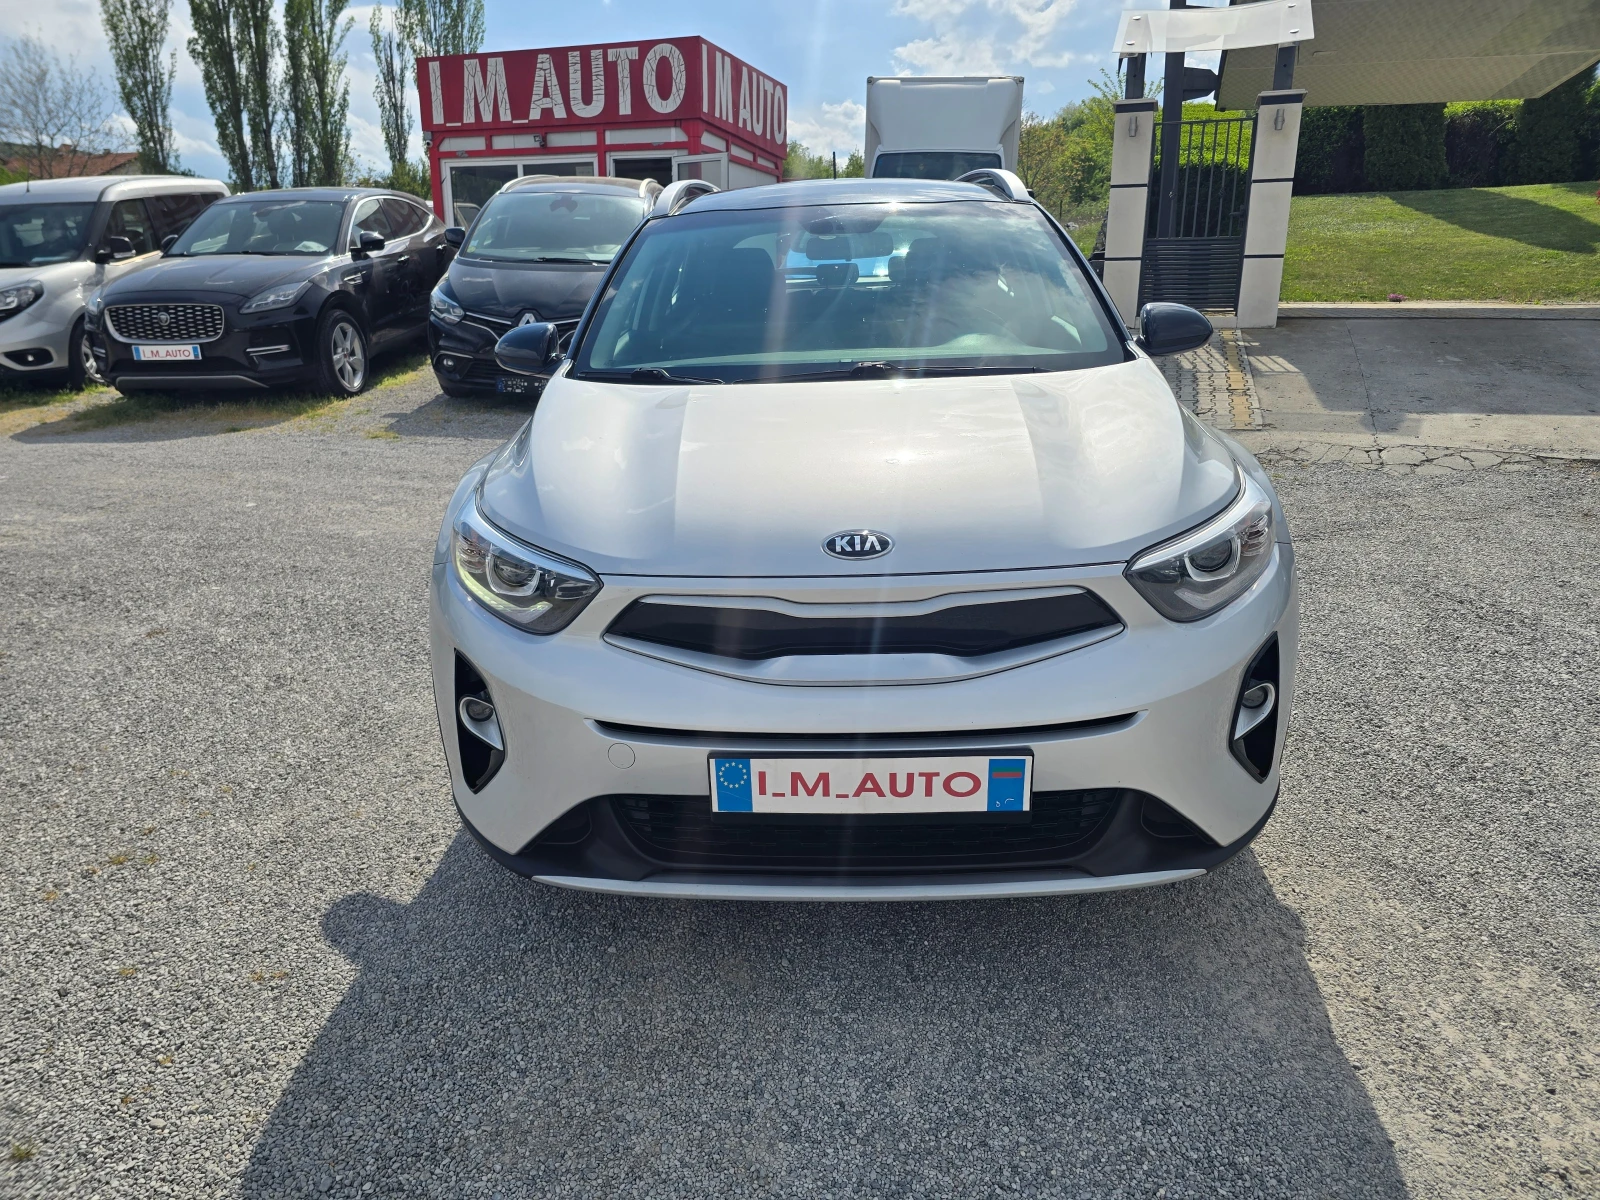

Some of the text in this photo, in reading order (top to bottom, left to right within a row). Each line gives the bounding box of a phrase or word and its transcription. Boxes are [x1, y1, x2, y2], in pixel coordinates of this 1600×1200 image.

[702, 43, 785, 145] I M AUTO
[834, 535, 882, 552] KIA
